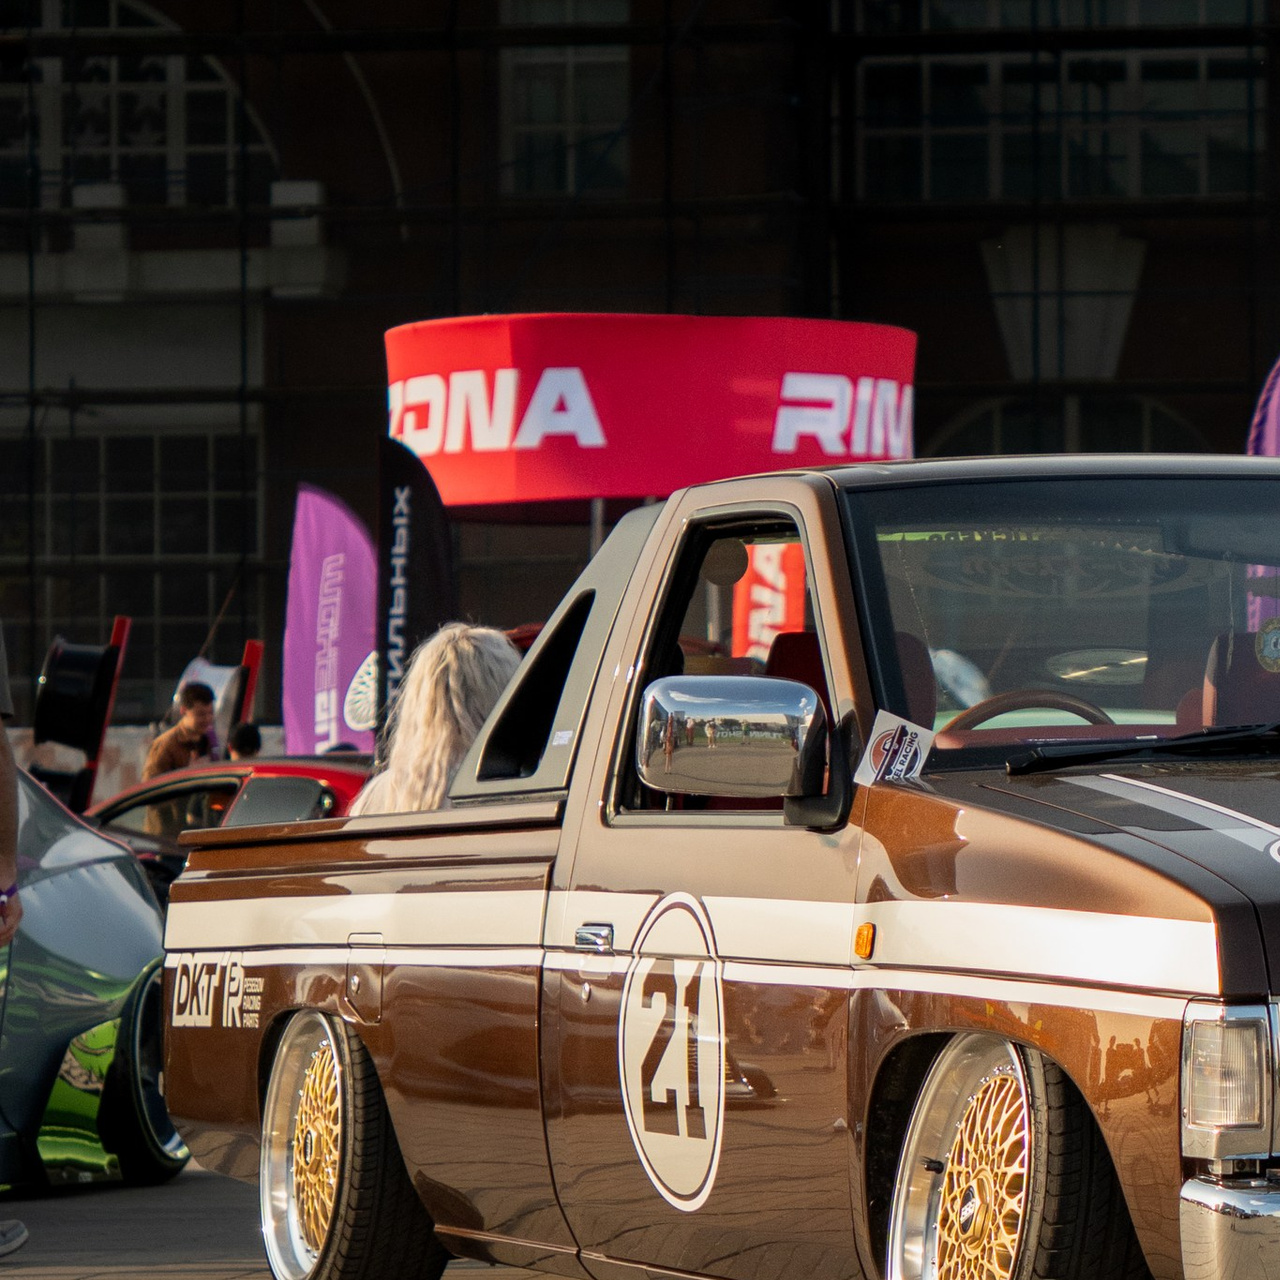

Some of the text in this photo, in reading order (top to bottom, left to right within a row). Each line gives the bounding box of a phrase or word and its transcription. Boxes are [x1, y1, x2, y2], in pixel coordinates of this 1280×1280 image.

[387, 485, 411, 705] ТИЛЬНЫХ
[899, 731, 919, 767] RACING
[173, 954, 220, 1027] DKT
[641, 958, 707, 1140] 21
